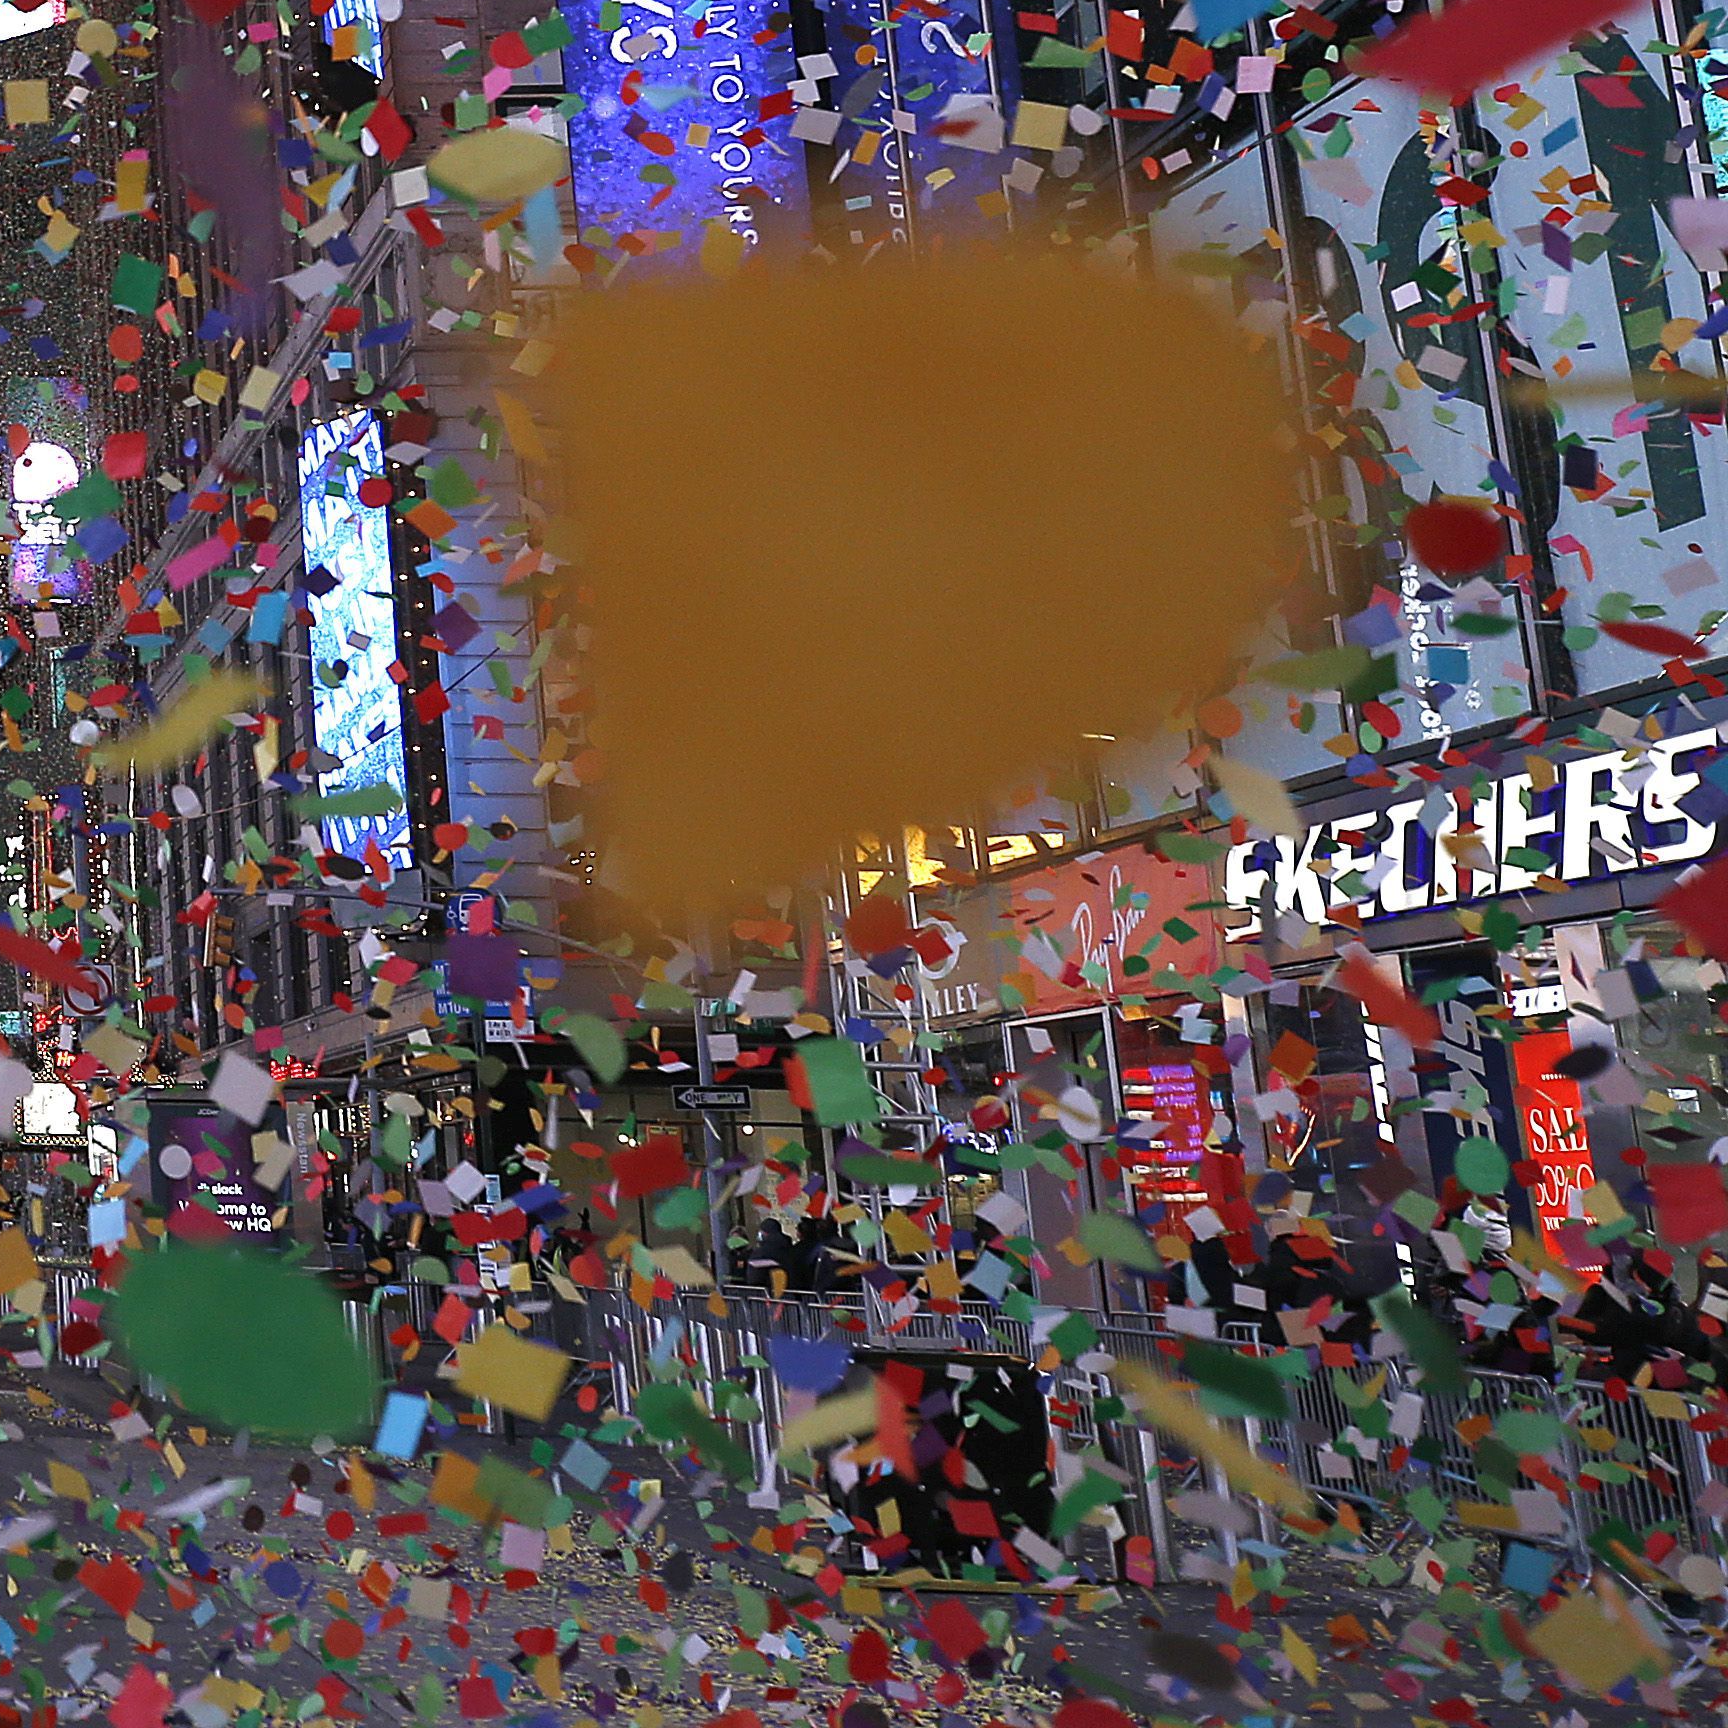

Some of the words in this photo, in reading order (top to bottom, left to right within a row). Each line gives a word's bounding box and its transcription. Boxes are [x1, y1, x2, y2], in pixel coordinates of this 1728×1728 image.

[708, 54, 745, 104] TO
[296, 1112, 309, 1174] Newsstan
[1529, 1107, 1588, 1154] SAL
[211, 1183, 243, 1195] slack
[178, 1200, 248, 1216] Wome
[251, 1202, 267, 1216] to
[246, 1217, 272, 1232] HQ
